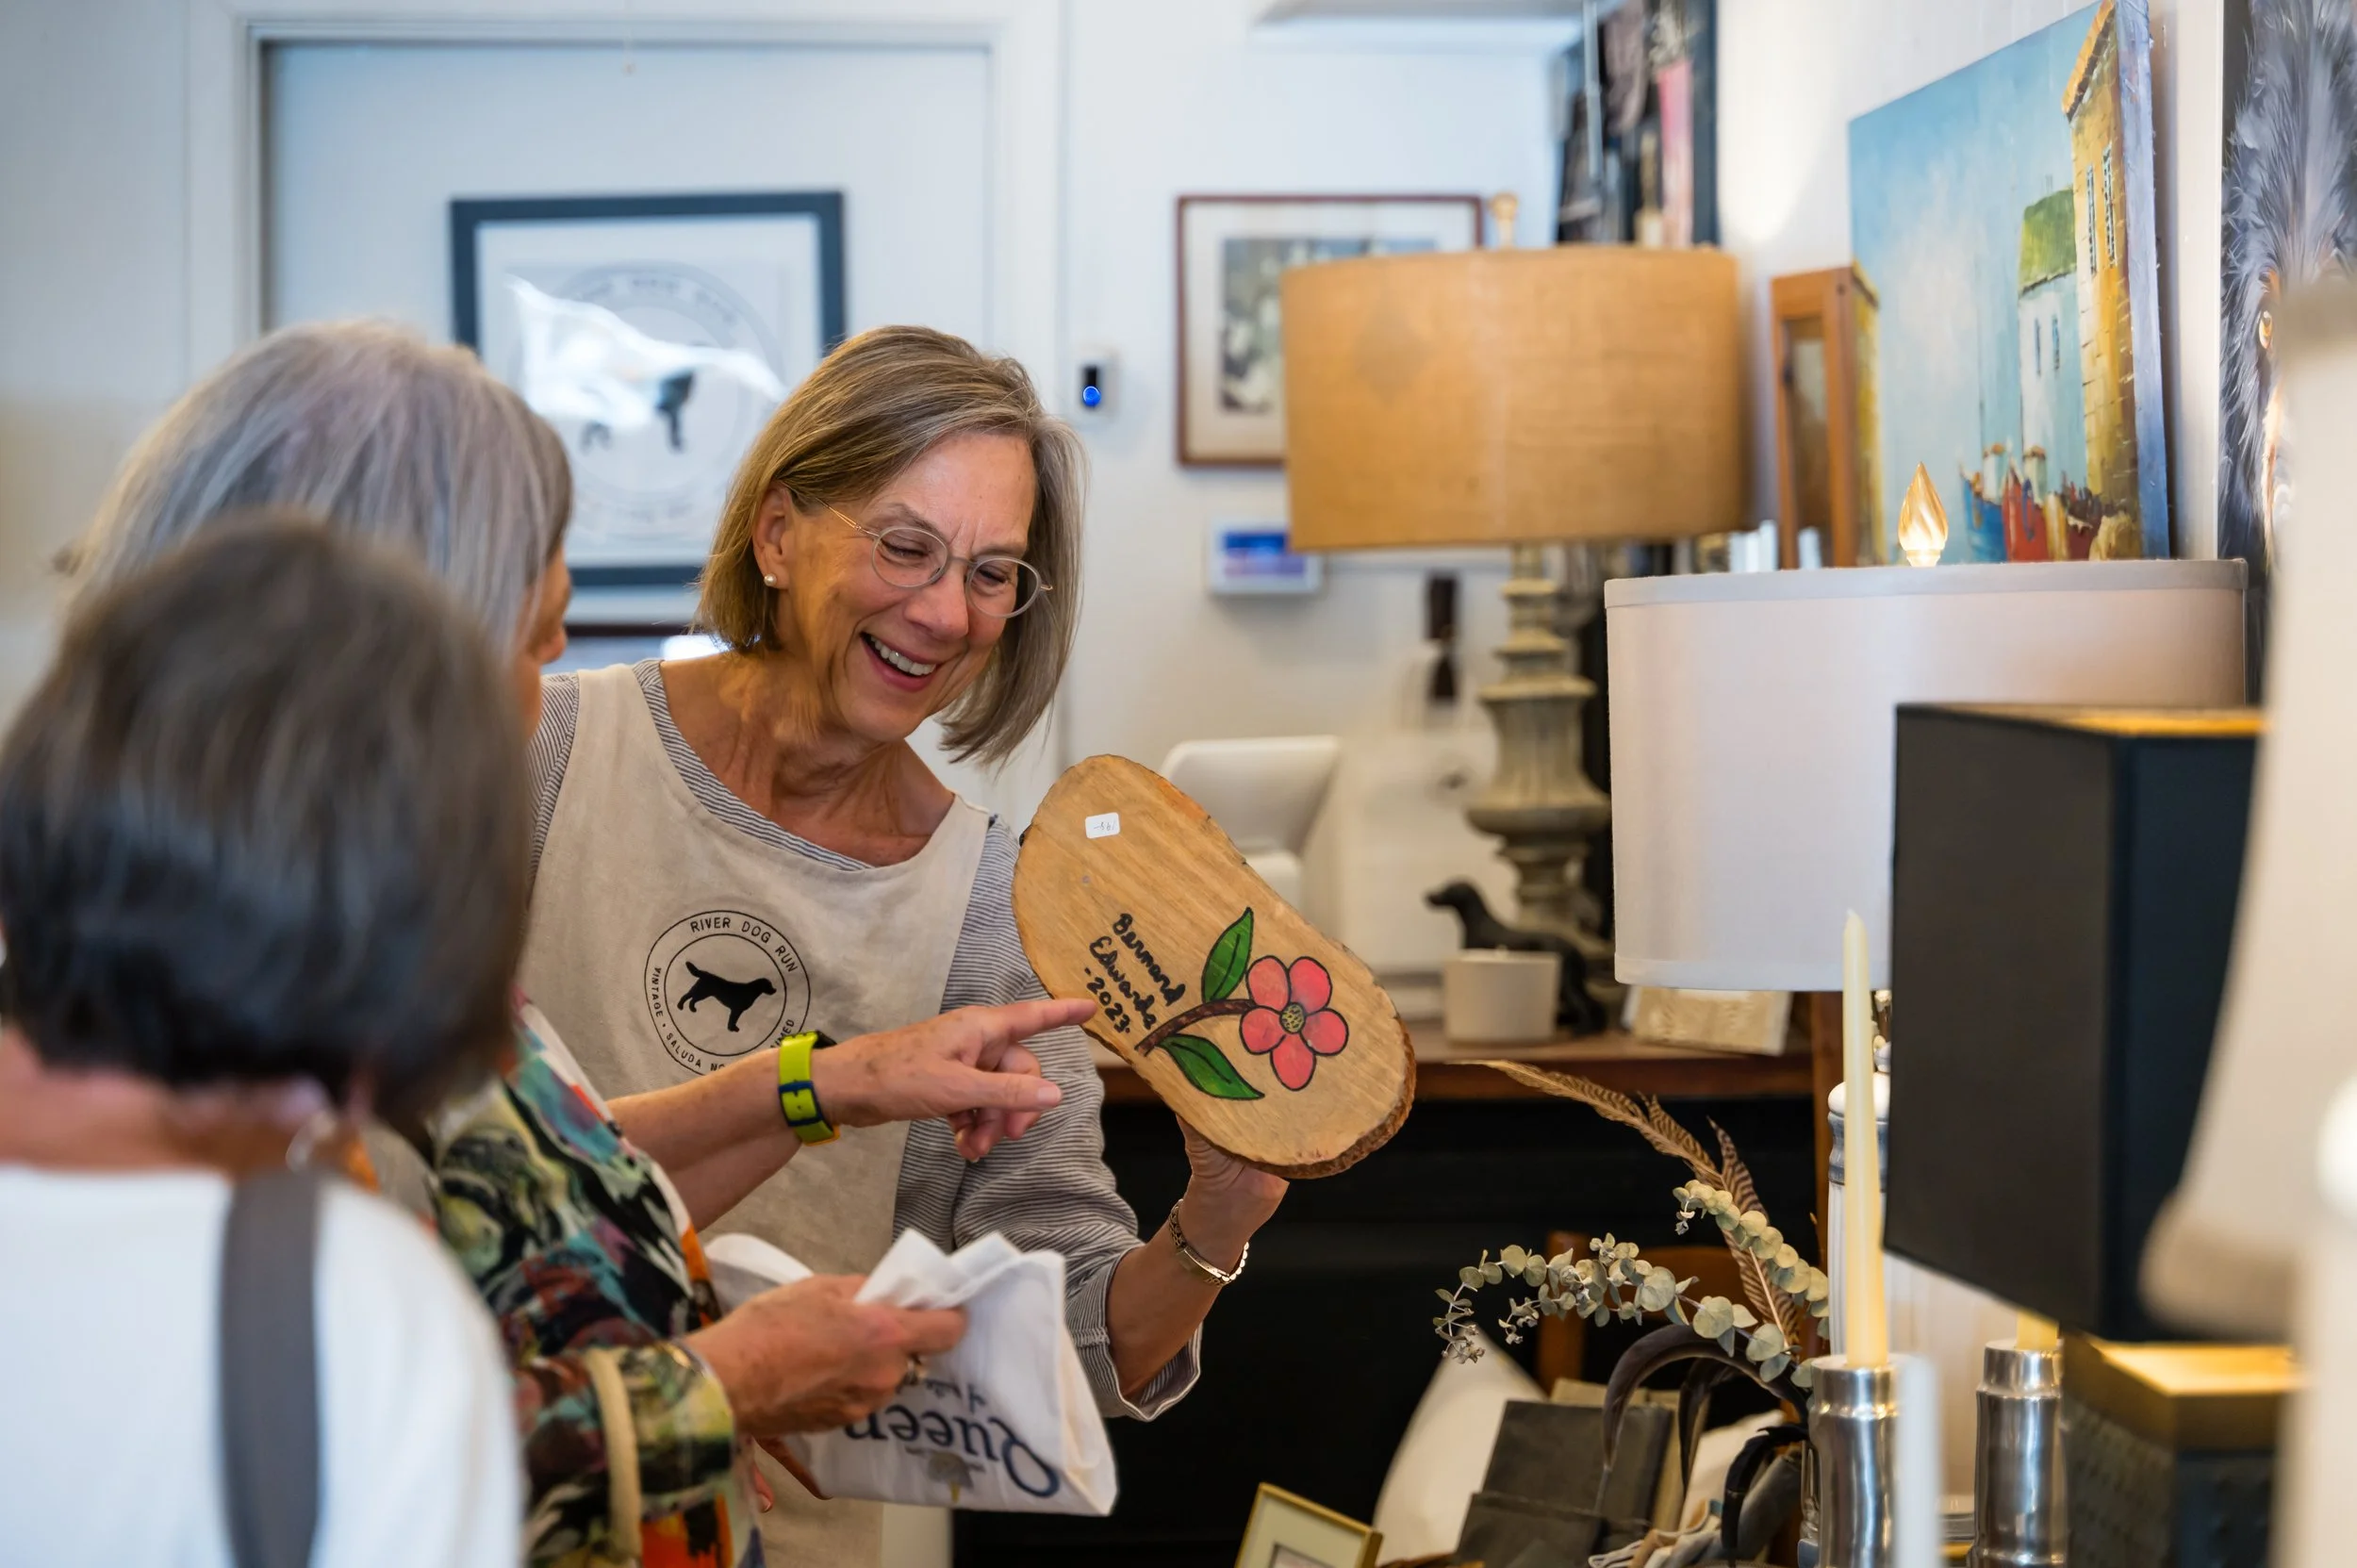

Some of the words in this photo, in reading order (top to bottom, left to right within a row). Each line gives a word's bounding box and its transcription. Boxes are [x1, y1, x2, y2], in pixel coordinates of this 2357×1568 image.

[690, 916, 732, 933] RIVER
[741, 920, 771, 944] DOG
[775, 945, 799, 972] RUN
[1089, 935, 1157, 1031] Edwards
[651, 967, 664, 1017] VINTAGE
[666, 1032, 702, 1068] SALUDA
[843, 1403, 1061, 1498] Queen
